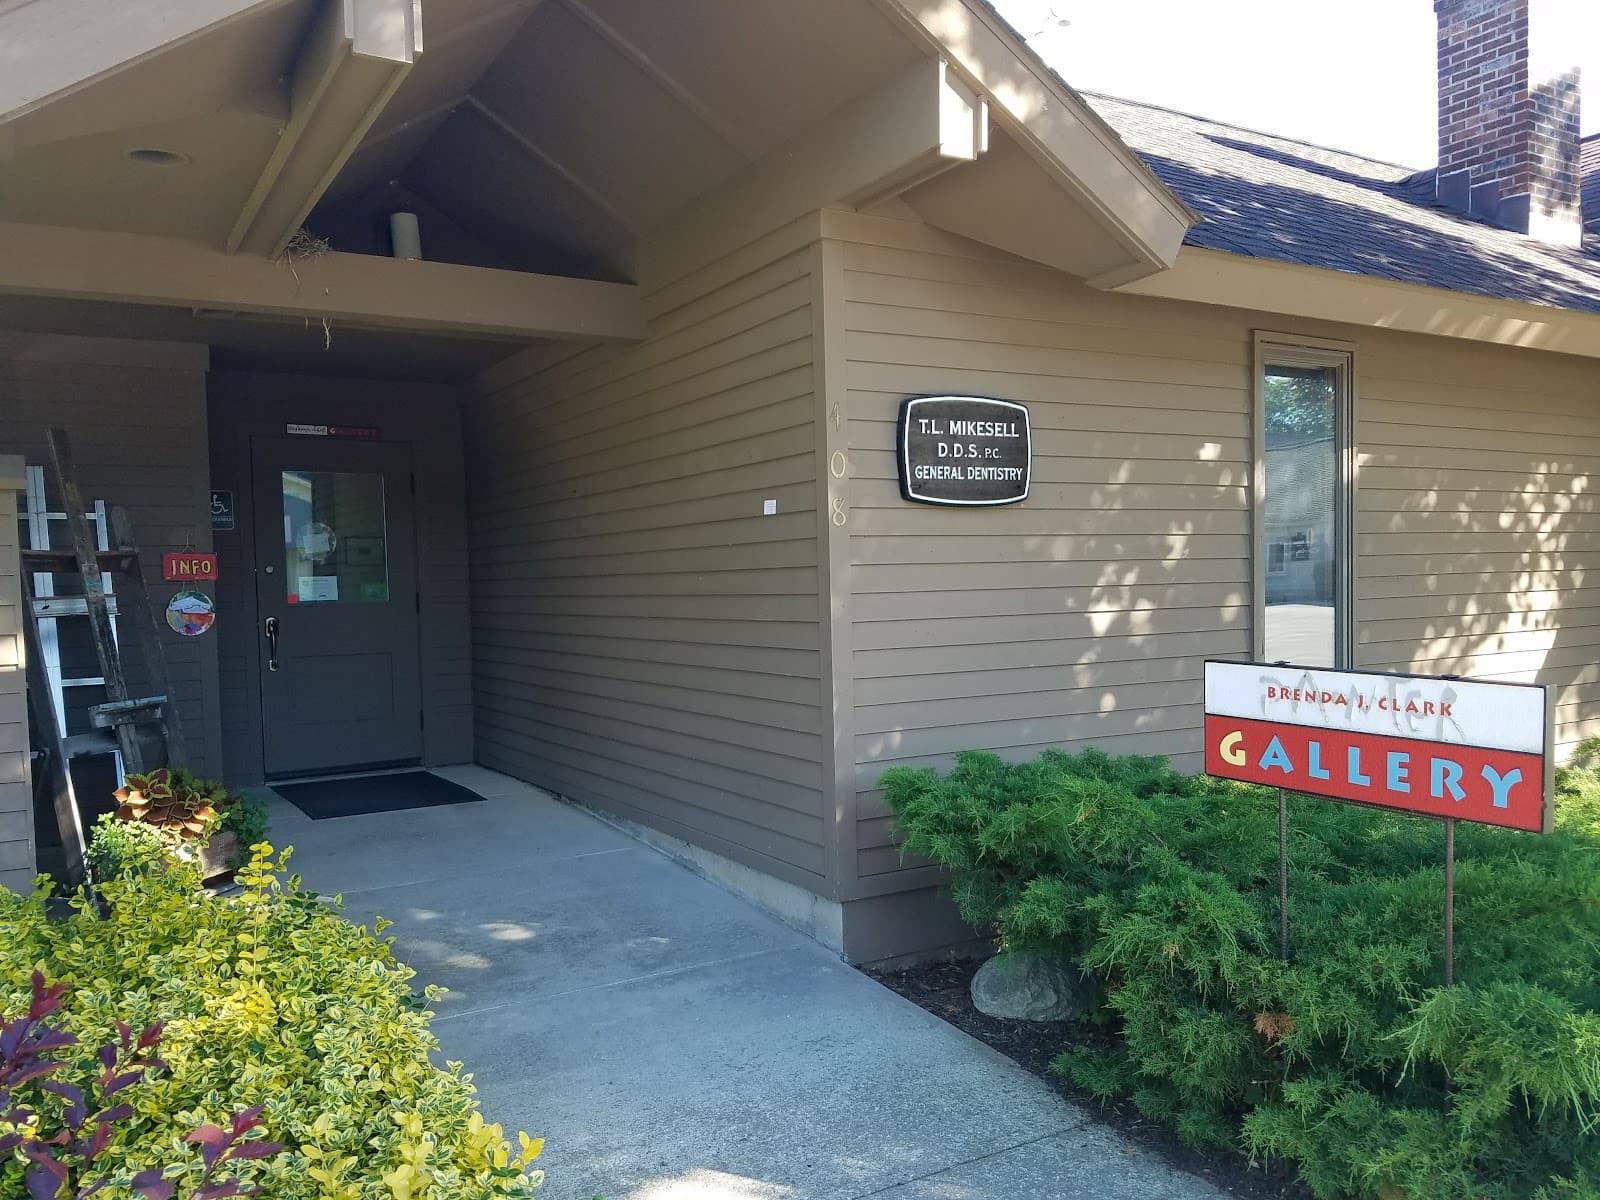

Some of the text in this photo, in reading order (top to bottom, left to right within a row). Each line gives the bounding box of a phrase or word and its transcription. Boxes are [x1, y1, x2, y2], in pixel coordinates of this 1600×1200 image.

[918, 419, 1020, 437] T.L. MIKESELL
[937, 442, 1002, 459] D.D.S. P.C.
[828, 402, 847, 527] 408
[914, 465, 1024, 481] GENERAL DENTISTRY
[171, 559, 211, 576] INFO
[1267, 685, 1348, 706] BRENDA
[1377, 696, 1453, 717] CLARK
[1219, 730, 1523, 808] GALLERY
